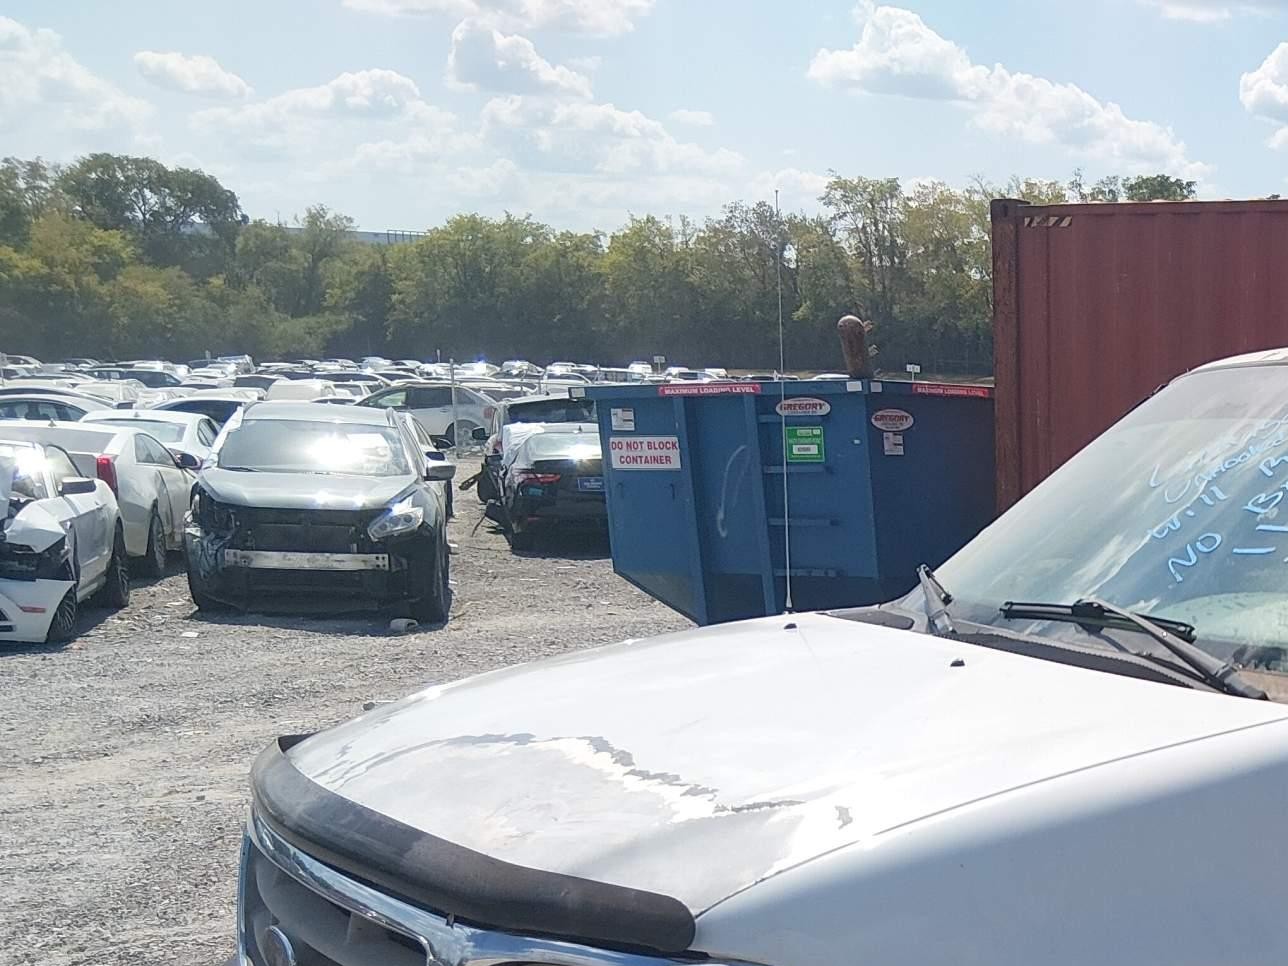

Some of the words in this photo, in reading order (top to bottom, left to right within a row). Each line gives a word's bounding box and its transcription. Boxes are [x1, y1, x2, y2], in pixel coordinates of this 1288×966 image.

[664, 387, 698, 395] MAXIMUM
[732, 386, 755, 394] LEVEL
[780, 402, 824, 411] GREGORY
[611, 441, 623, 450] DO
[626, 441, 644, 450] NOT
[647, 441, 678, 450] BLOCK
[619, 454, 672, 465] CONTAINER
